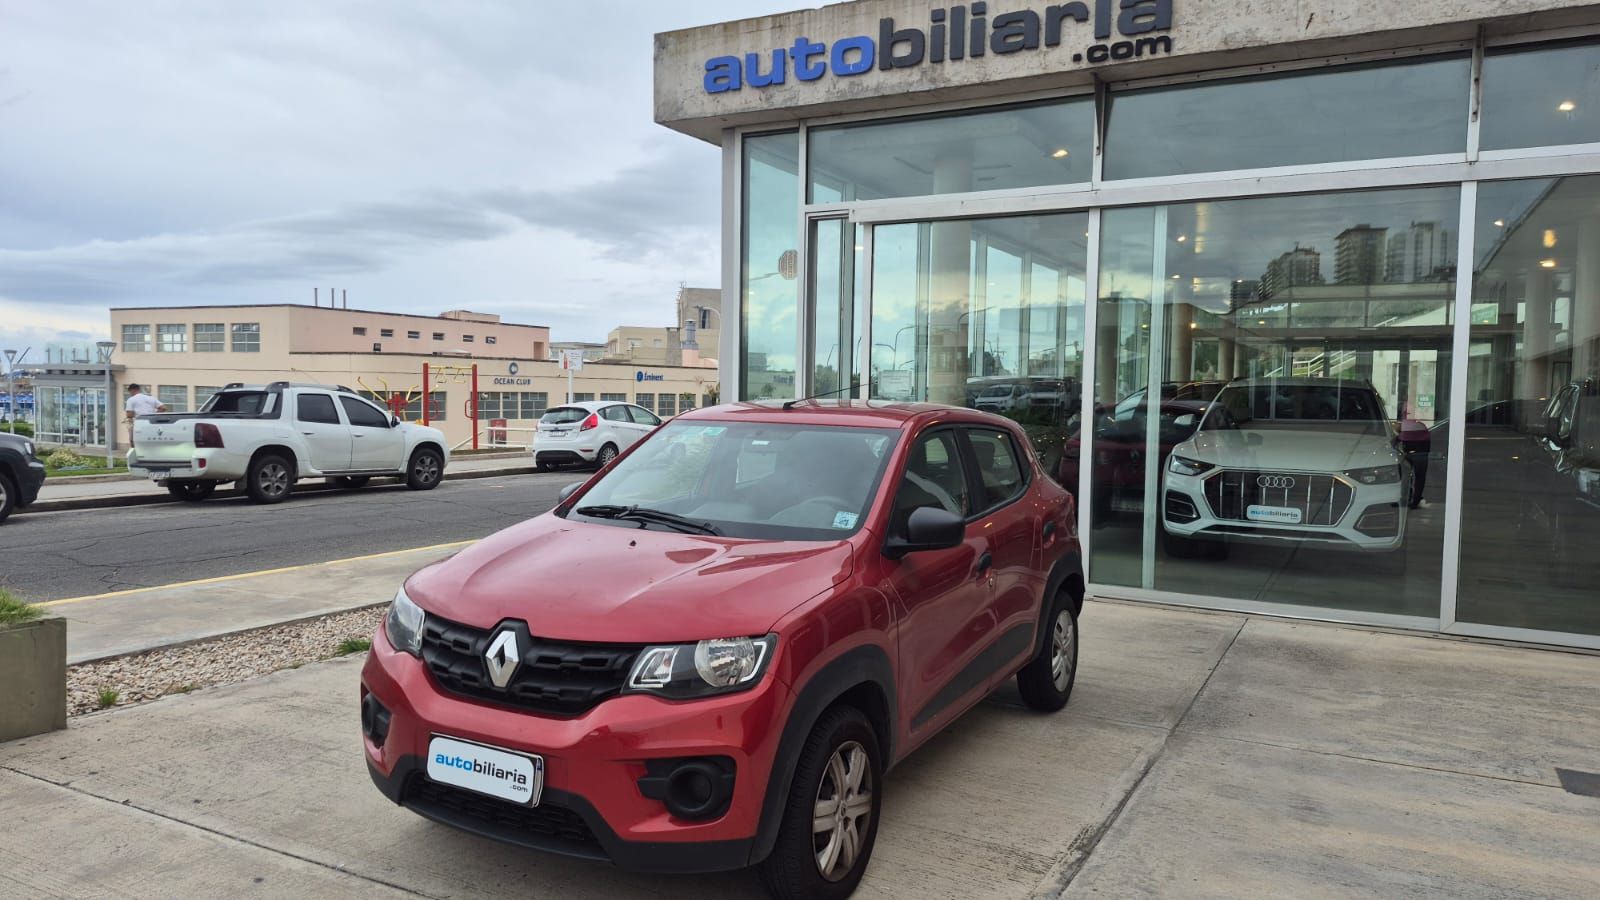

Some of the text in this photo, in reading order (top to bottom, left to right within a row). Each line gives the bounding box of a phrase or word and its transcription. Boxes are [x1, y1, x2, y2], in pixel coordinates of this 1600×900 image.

[703, 0, 1173, 94] autobiliaria
[1072, 35, 1172, 64] .com
[494, 377, 515, 385] OCEAN
[435, 753, 527, 785] autobiliaria
[509, 784, 528, 793] .com
